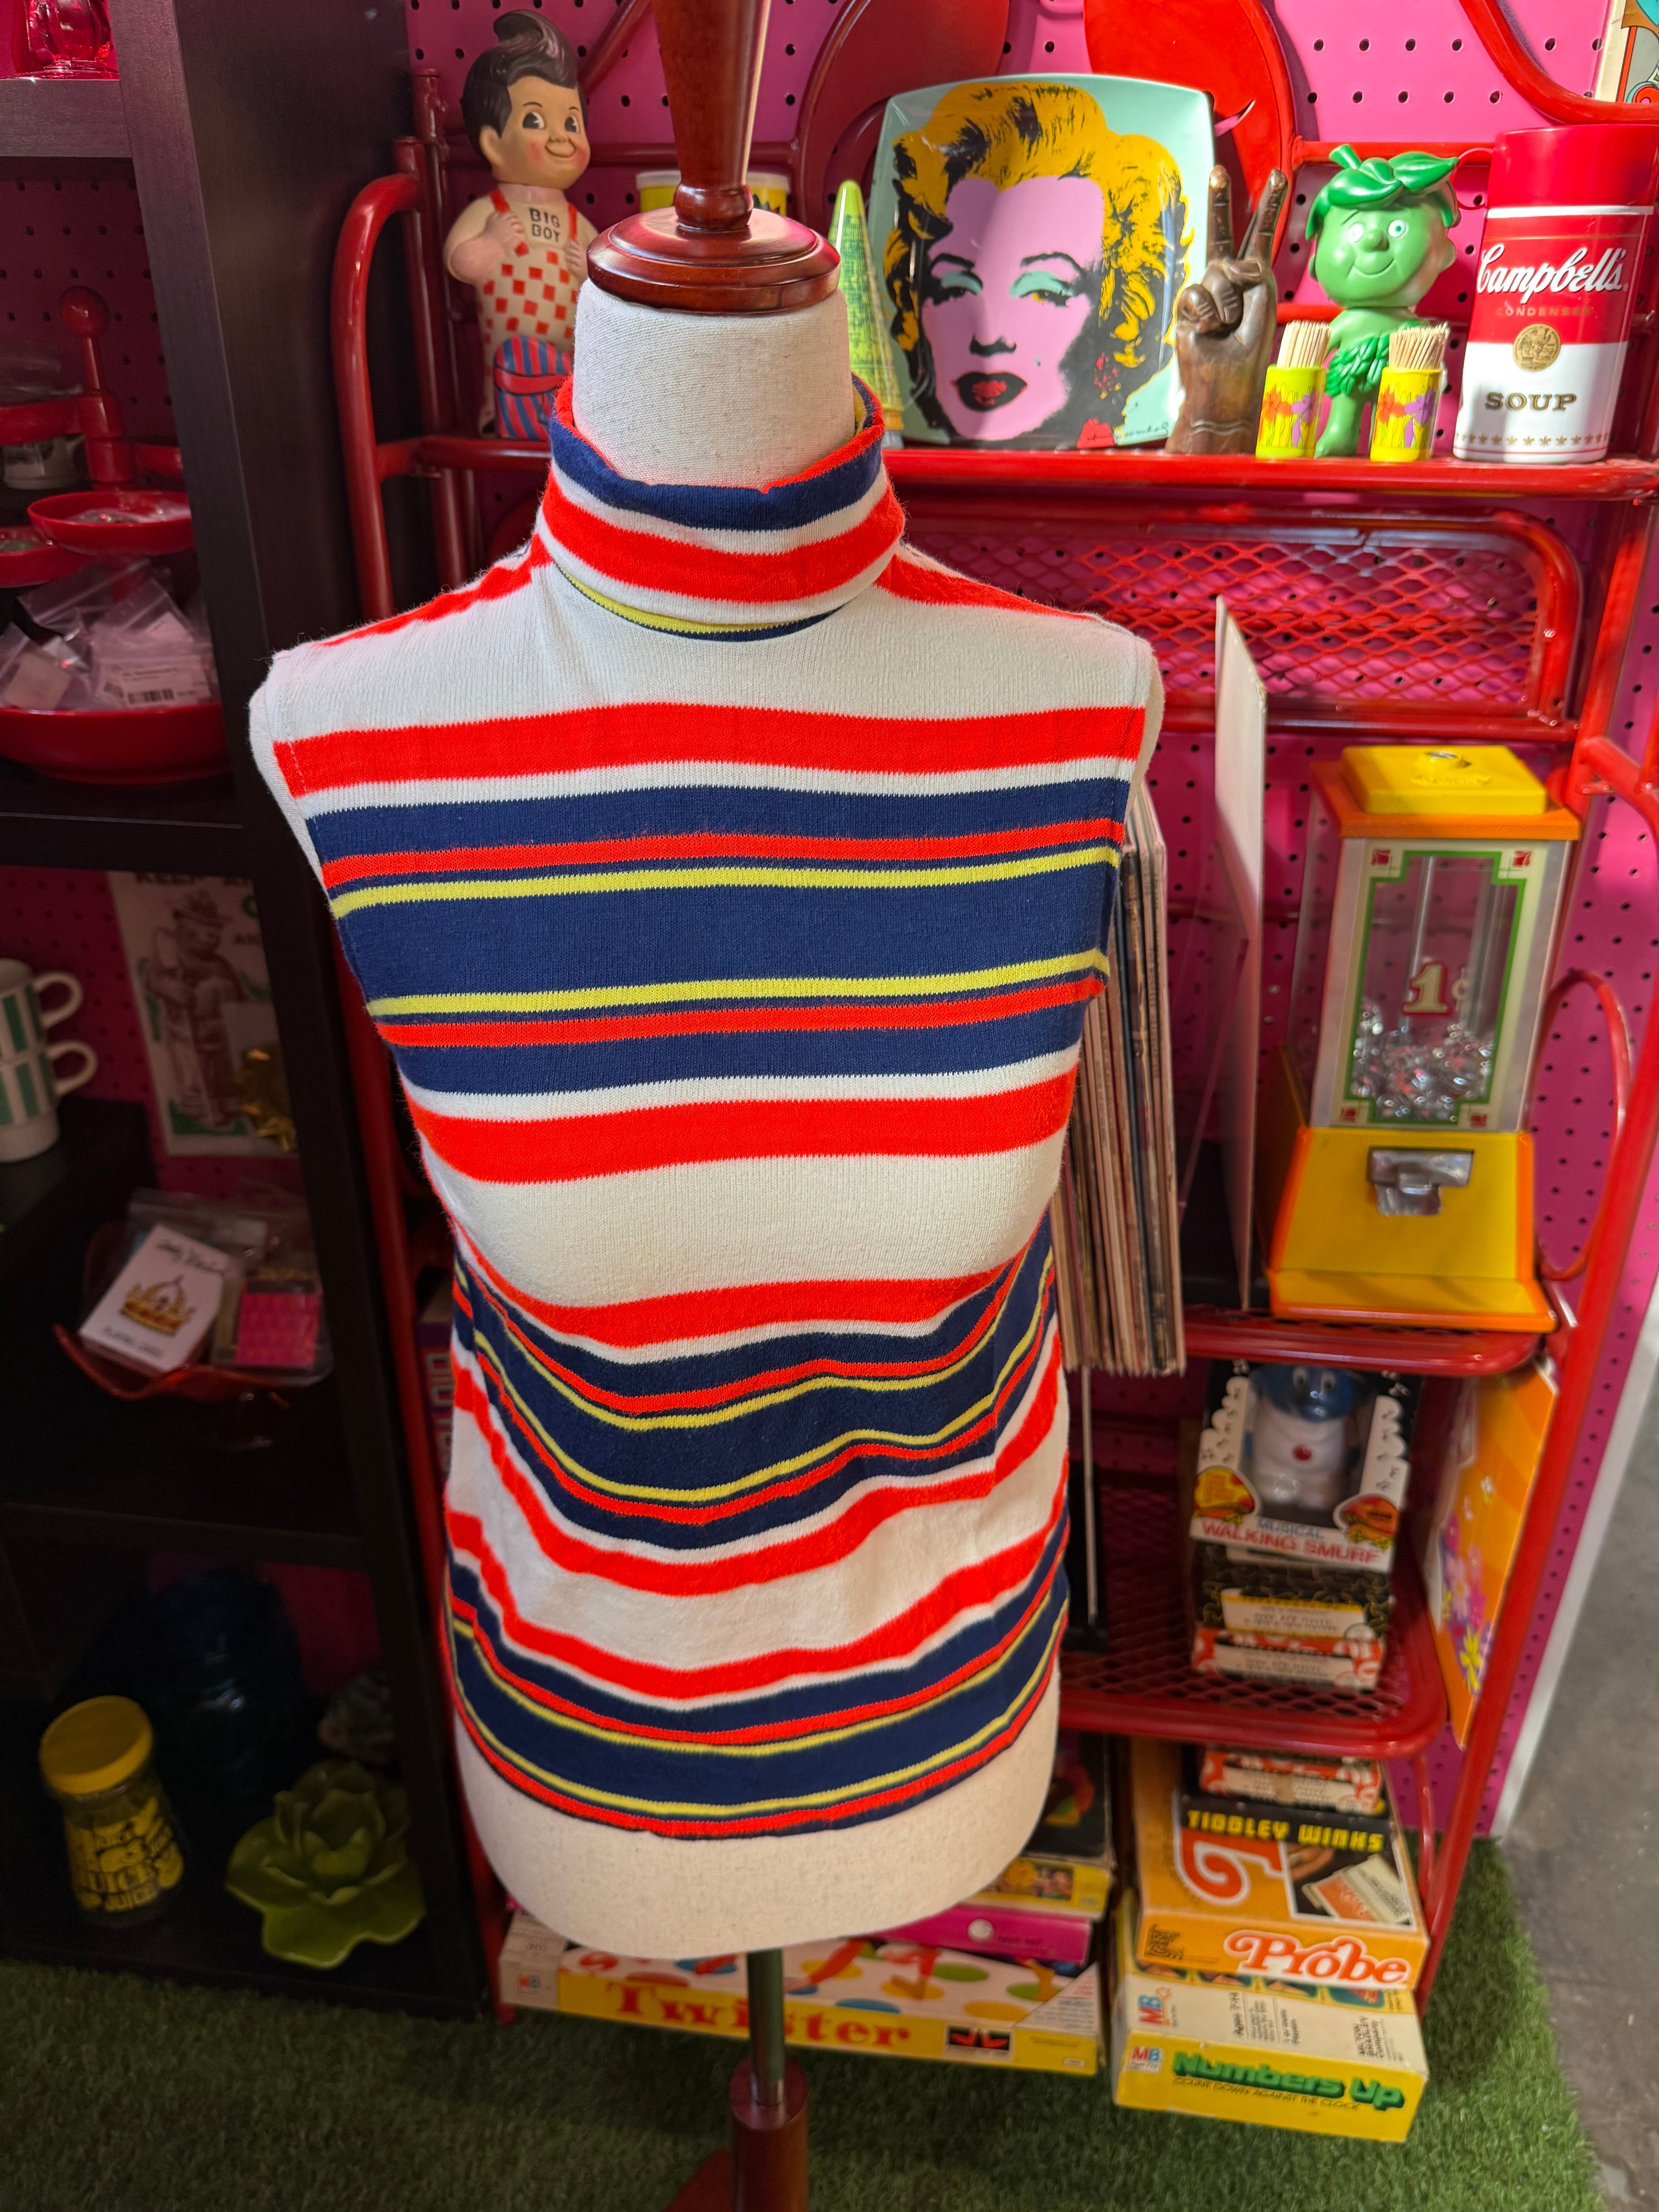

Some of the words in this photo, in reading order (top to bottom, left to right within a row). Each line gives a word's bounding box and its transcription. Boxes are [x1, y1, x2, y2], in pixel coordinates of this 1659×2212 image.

[528, 207, 560, 228] BIG
[531, 223, 560, 242] BOY
[1477, 244, 1627, 304] Campbell's
[1496, 306, 1591, 317] CONDENSED
[1484, 391, 1577, 412] SOUP
[1256, 1518, 1325, 1539] MUSICAL
[1201, 1521, 1297, 1552] WALKING
[1303, 1539, 1381, 1564] SMURF
[1187, 1810, 1290, 1842] TIDDLEY
[1297, 1824, 1385, 1854] WINKS
[1224, 1930, 1411, 1985] Probe
[1133, 2046, 1160, 2062] MB
[1173, 2051, 1345, 2099] Numbers
[1348, 2077, 1405, 2111] Up
